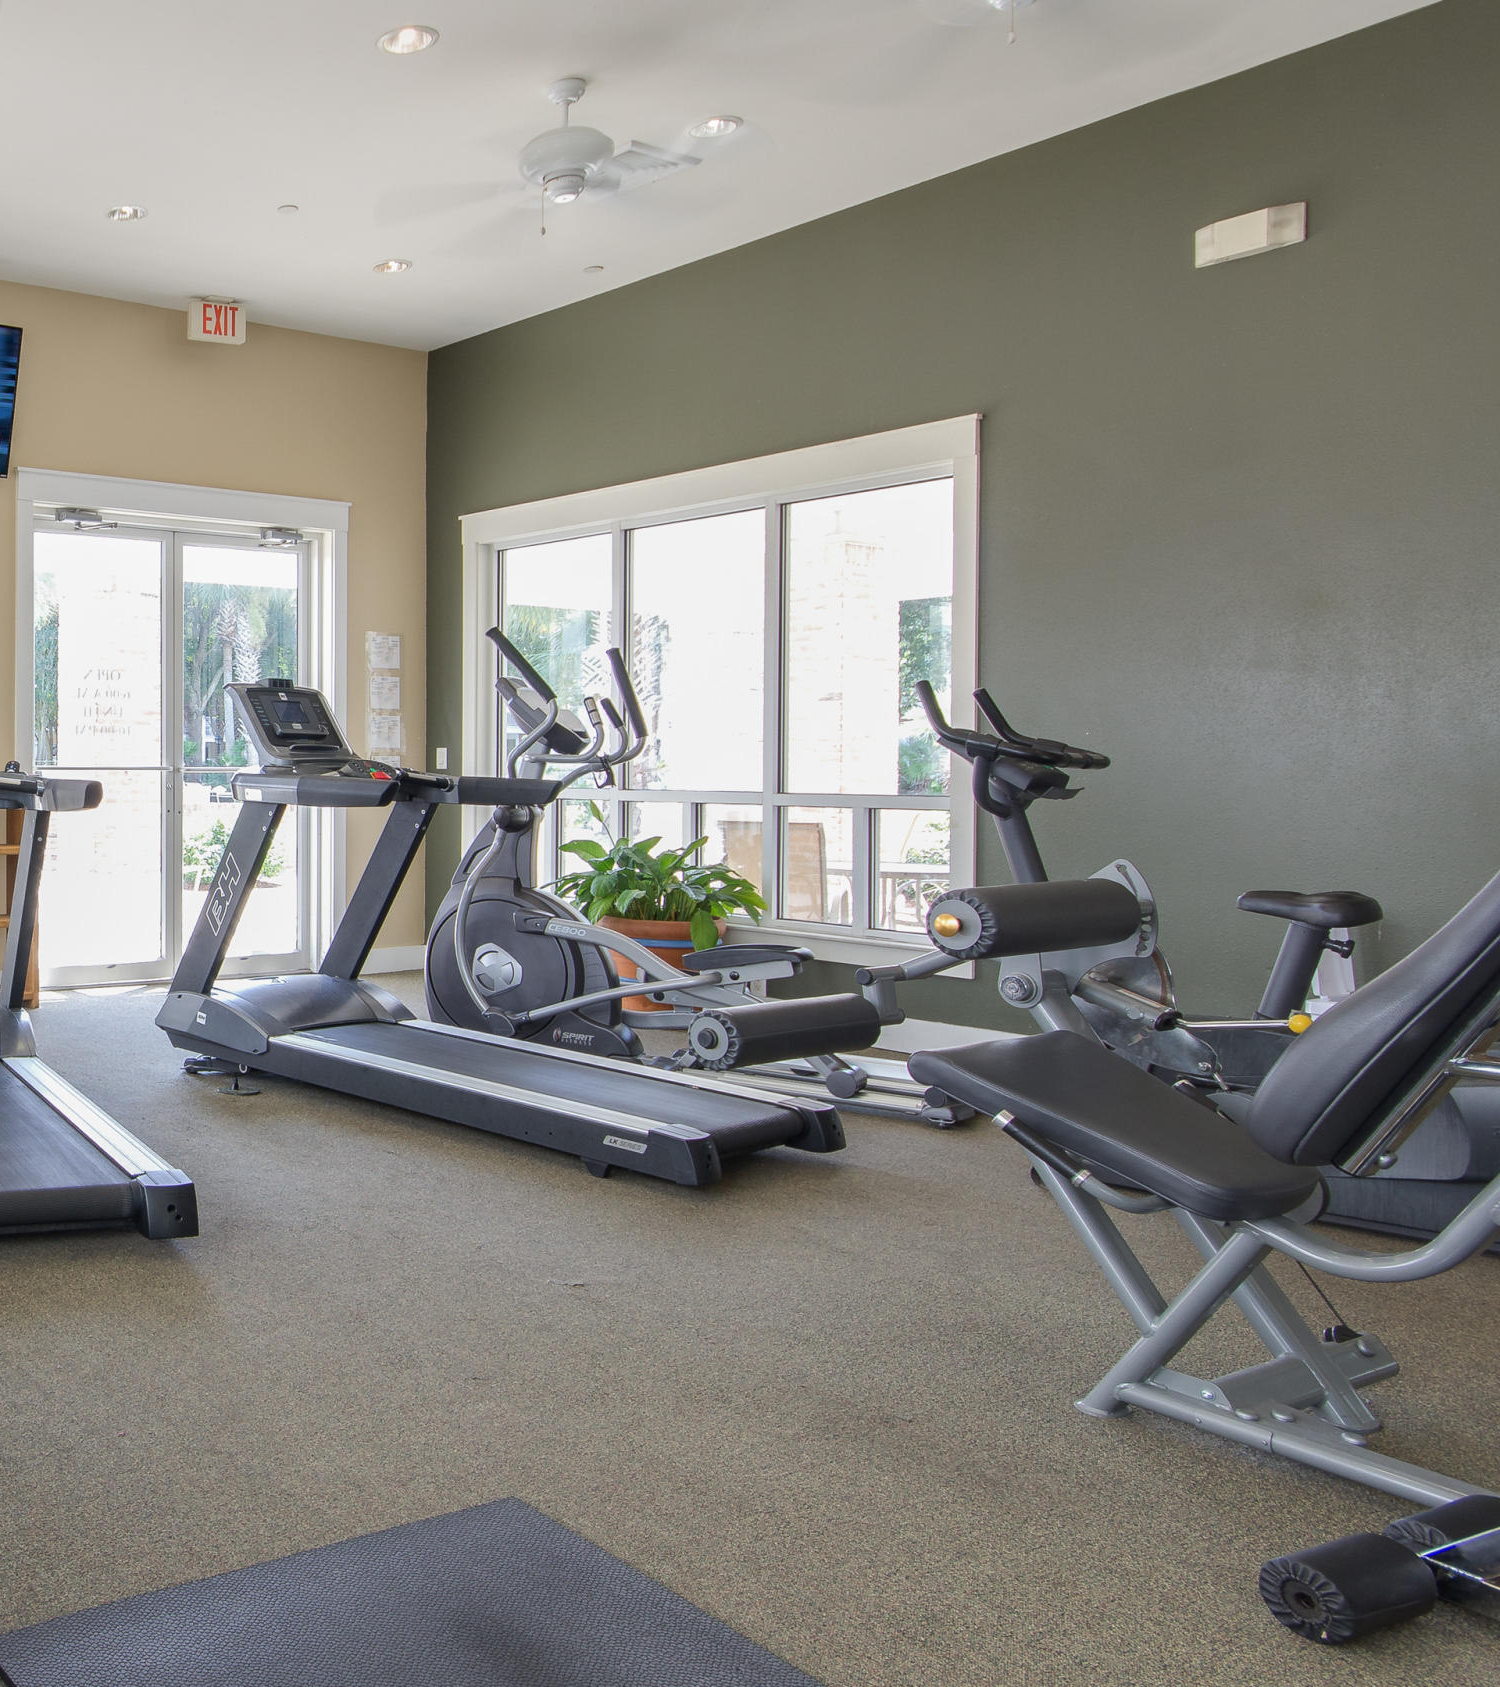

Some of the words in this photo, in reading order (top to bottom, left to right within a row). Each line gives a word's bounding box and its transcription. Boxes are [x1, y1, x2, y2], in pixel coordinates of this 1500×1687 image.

[203, 303, 238, 337] EXIT
[206, 852, 241, 936] BH
[548, 923, 587, 937] CE800
[563, 1031, 595, 1042] SPIRIT
